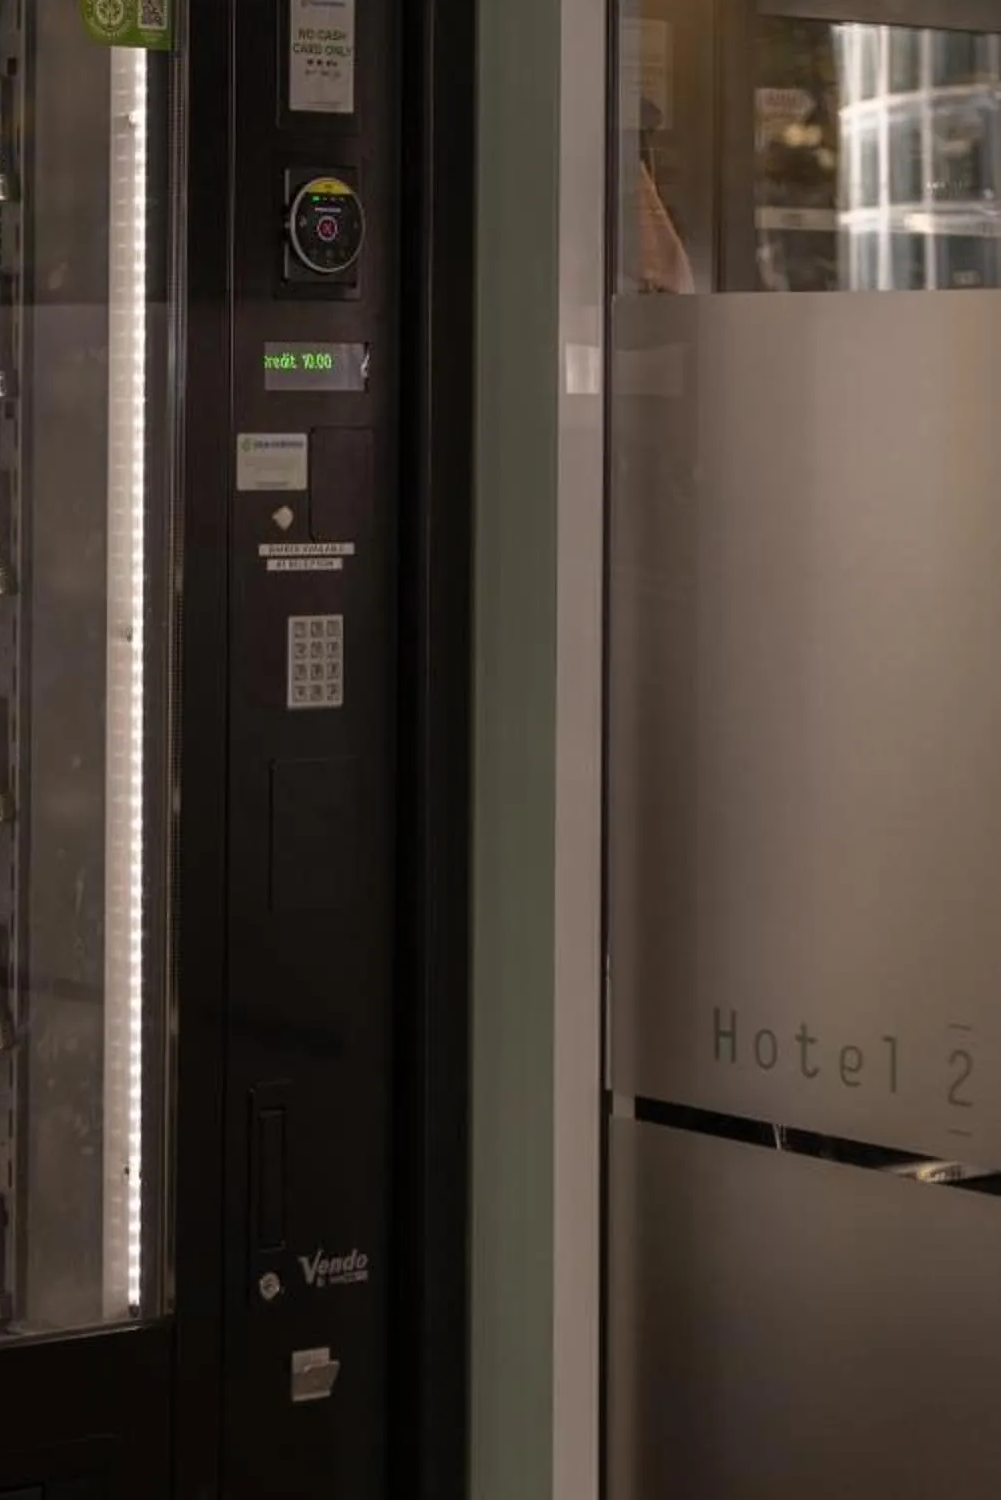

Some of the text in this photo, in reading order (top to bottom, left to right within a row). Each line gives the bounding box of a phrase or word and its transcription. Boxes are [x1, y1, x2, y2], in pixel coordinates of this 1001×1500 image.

[712, 1005, 975, 1109] Hotel 2
[297, 1247, 370, 1286] Vendo
